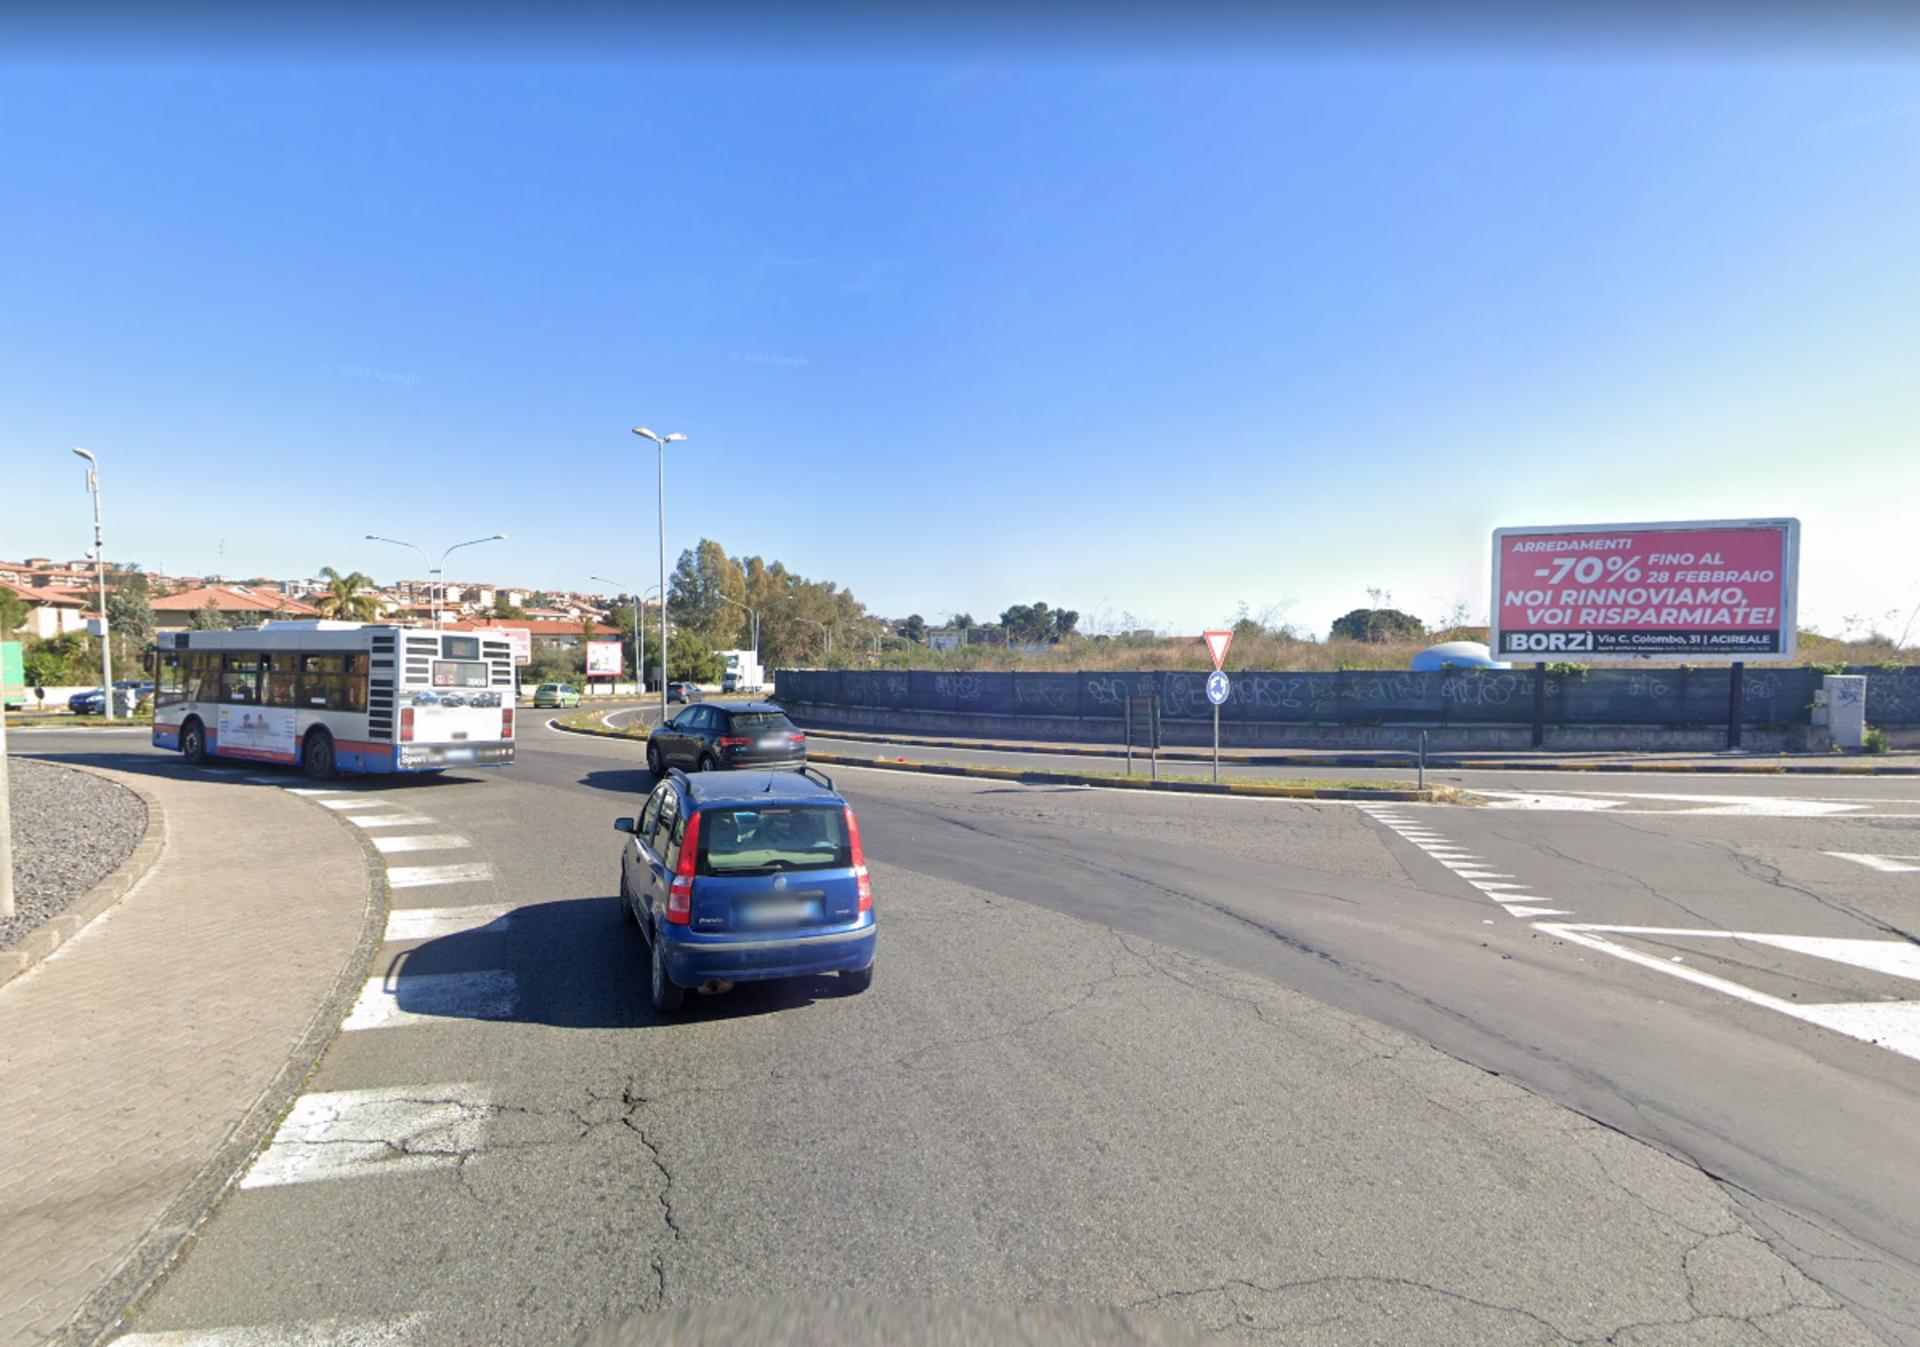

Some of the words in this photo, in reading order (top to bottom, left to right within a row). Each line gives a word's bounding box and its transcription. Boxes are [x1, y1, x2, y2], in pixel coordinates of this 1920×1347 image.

[1512, 538, 1632, 552] ARREDAMENTI
[1648, 552, 1694, 565] FINO
[1698, 552, 1724, 565] AL
[1534, 555, 1641, 584] -70%
[1646, 571, 1670, 583] 28
[1674, 570, 1774, 583] FEBBRAIO
[1504, 589, 1553, 606] NOI
[1559, 587, 1748, 607] RINNOVIAMO,
[1526, 608, 1573, 624] VOI
[1578, 607, 1776, 624] RISPARMIATE!
[1511, 631, 1593, 650] BORZÌ
[1597, 635, 1616, 643] Via
[1618, 635, 1630, 643] C.
[1632, 634, 1687, 645] Colombo,
[1689, 635, 1700, 643] 31
[1709, 634, 1770, 644] ACIREALE
